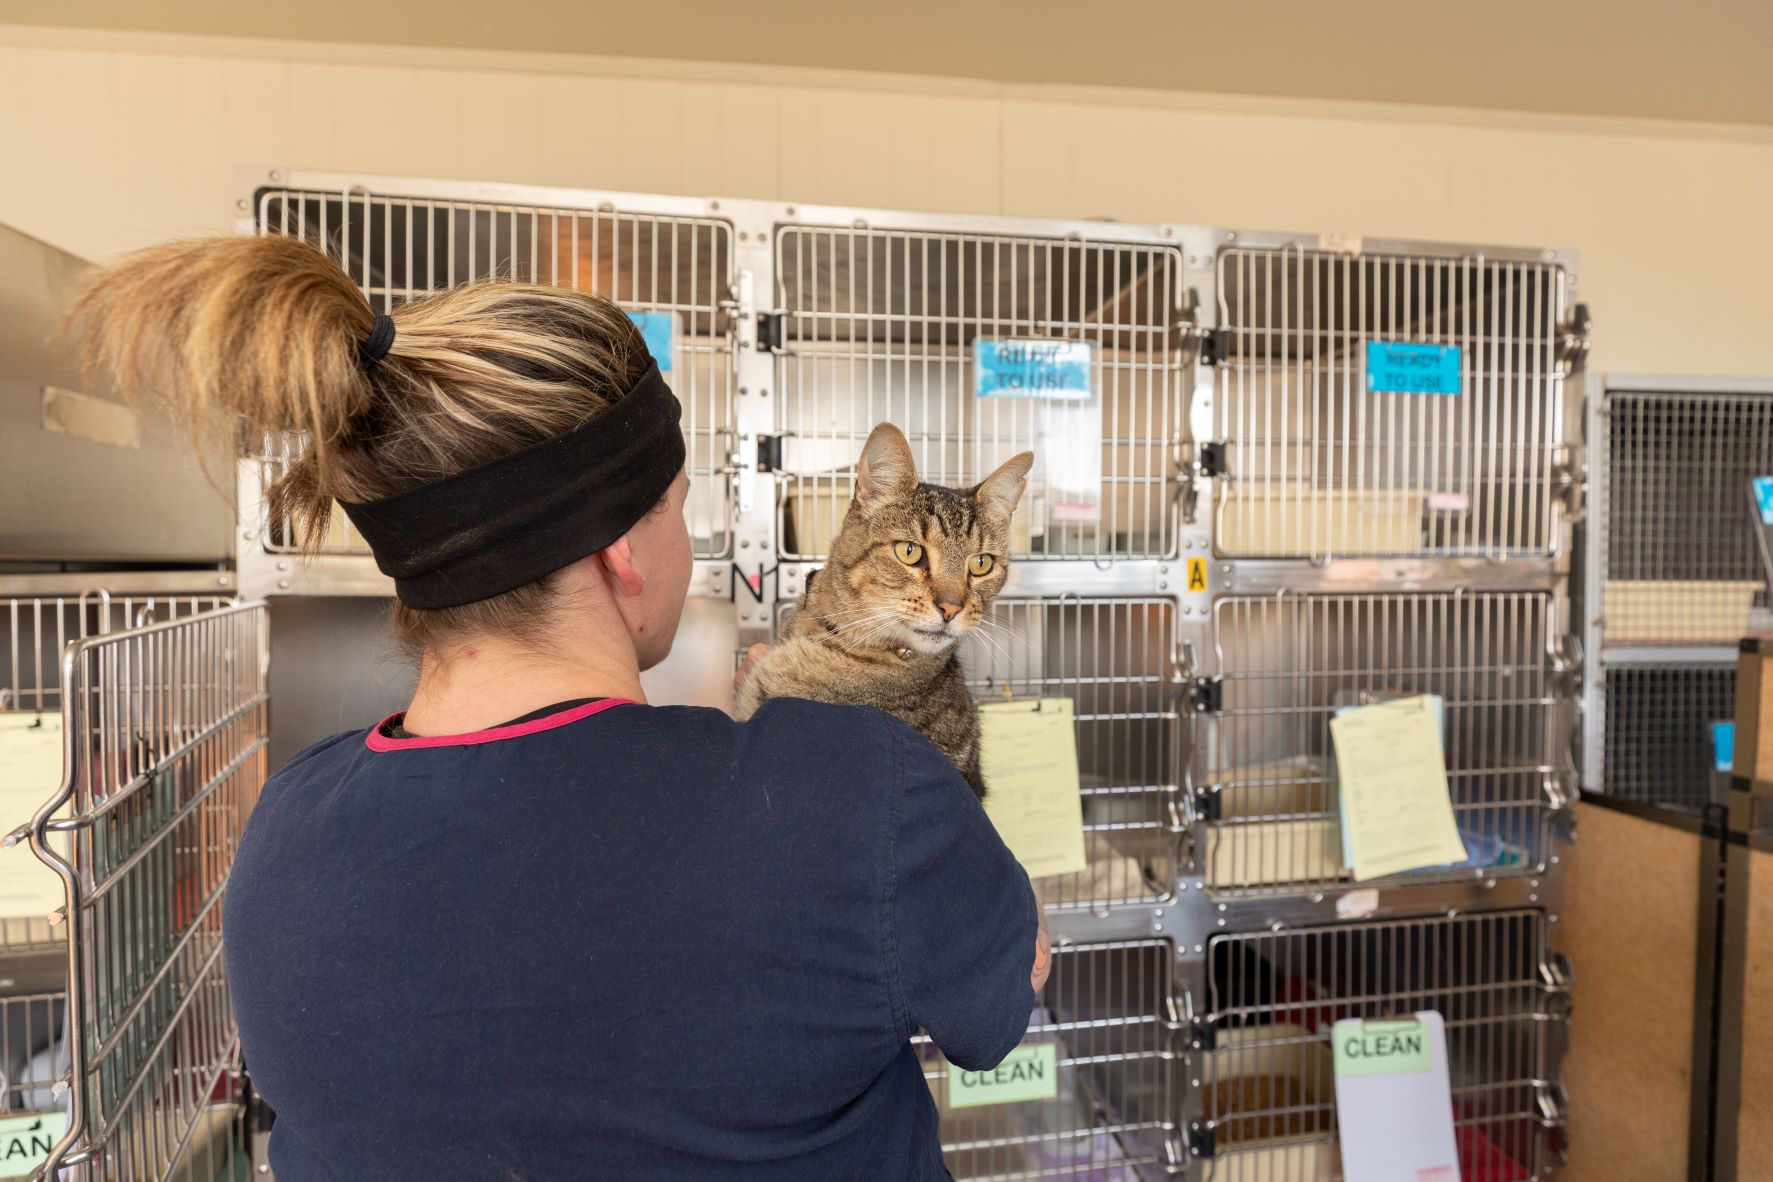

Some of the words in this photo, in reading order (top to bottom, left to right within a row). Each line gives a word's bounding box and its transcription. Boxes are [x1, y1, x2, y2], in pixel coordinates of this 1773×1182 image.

[999, 346, 1060, 365] REY
[1387, 353, 1441, 368] READY
[995, 371, 1024, 388] TO
[1029, 372, 1069, 389] USE
[1386, 373, 1408, 387] TO
[1411, 375, 1441, 389] USE
[1190, 560, 1204, 588] A
[1344, 1035, 1421, 1060] CLEAN
[960, 1061, 1044, 1089] CLEAN
[0, 1134, 52, 1160] AN
